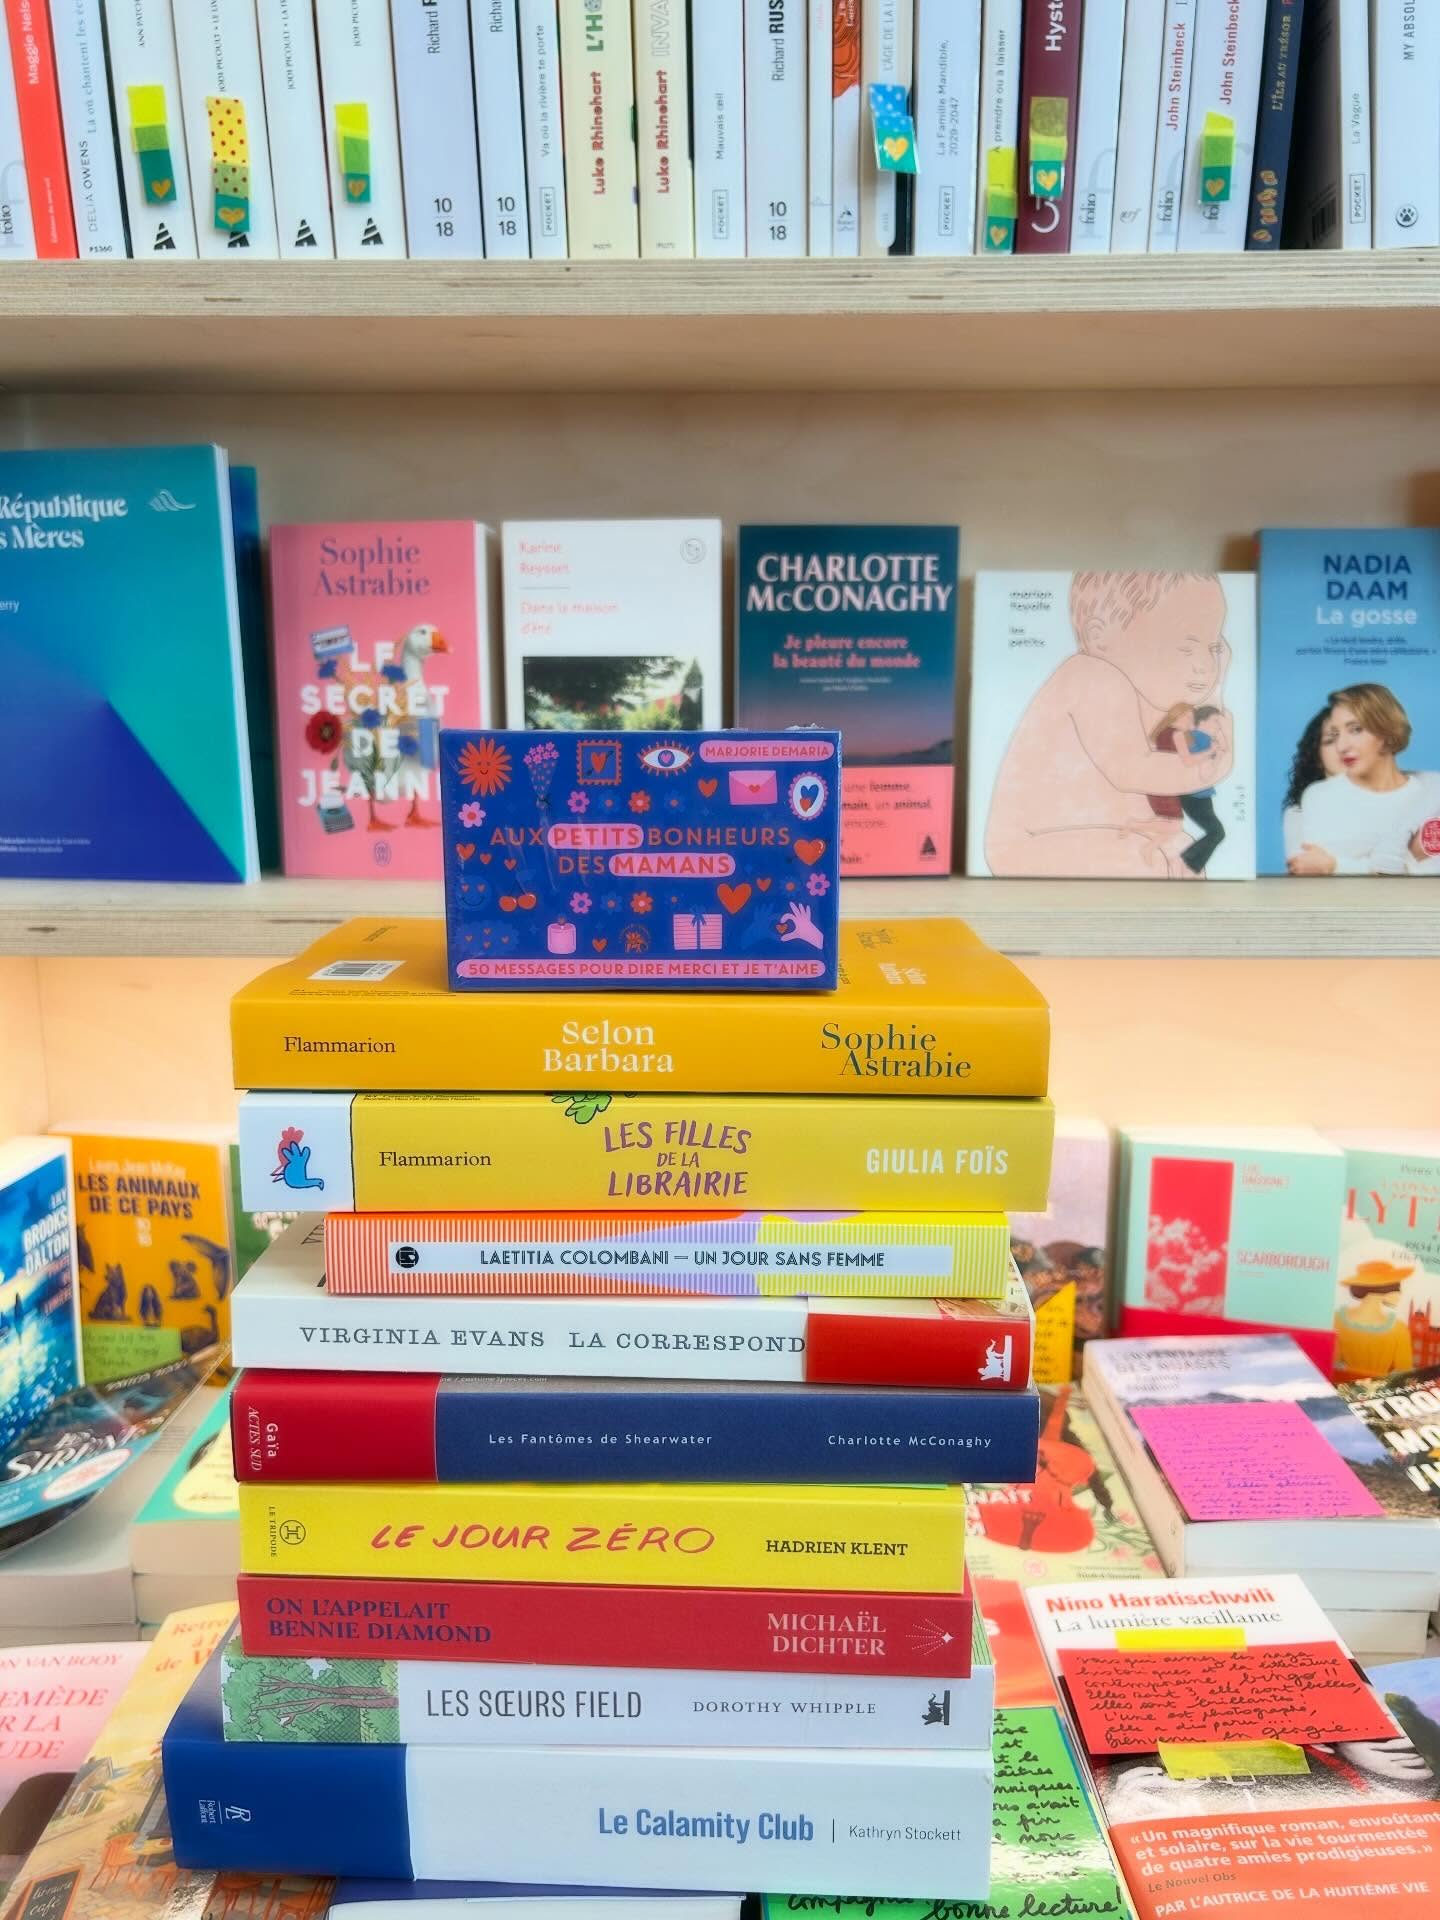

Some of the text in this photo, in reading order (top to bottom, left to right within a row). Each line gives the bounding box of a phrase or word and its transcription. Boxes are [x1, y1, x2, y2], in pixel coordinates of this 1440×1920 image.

[427, 10, 441, 54] Richard
[536, 25, 548, 55] porte
[882, 24, 894, 41] DE
[27, 34, 42, 85] Maggie
[213, 33, 225, 70] PICOULT
[771, 38, 785, 81] Richard
[1403, 43, 1415, 60] MY
[79, 42, 93, 96] chantent
[1166, 22, 1185, 131] John Steinbeck
[1220, 71, 1234, 105] John
[937, 100, 947, 137] Famille
[1351, 92, 1363, 127] Vague
[588, 71, 606, 195] Luke Rhinehart
[655, 69, 670, 193] Luke Rhinehart
[714, 113, 725, 160] Mauvais
[79, 140, 98, 232] DELIA OWENS
[433, 197, 453, 213] 10
[496, 196, 516, 212] 10
[769, 201, 787, 216] 10
[1080, 193, 1096, 224] folio
[1157, 191, 1174, 224] folio
[435, 221, 454, 237] 18
[499, 220, 517, 236] 18
[769, 226, 787, 241] 18
[13, 524, 85, 549] Mères
[319, 536, 421, 574] Sophie
[757, 553, 940, 583] CHARLOTTE
[1323, 555, 1412, 575] NADIA
[313, 568, 431, 597] Astrabie
[1326, 581, 1409, 601] DAAM
[1315, 606, 1419, 630] La gosse
[805, 633, 853, 652] pleure
[792, 653, 921, 669] beauté monde
[300, 684, 450, 716] SECRET
[351, 728, 400, 759] DE
[705, 745, 830, 758] MARJORIE DEMARIA
[490, 827, 792, 846] AUX PETITS BONHEURS
[558, 855, 731, 874] DES MAMANS
[468, 962, 762, 976] 50 MESSAGES POUR DIRE MERCI ET JE
[284, 1019, 937, 1058] Flammarion Selon Sophie
[543, 1047, 972, 1078] Barbara Astrabie
[604, 1119, 752, 1154] LES FILLES
[378, 1150, 492, 1167] Flammarion
[656, 1151, 700, 1168] DE LA
[866, 1145, 1009, 1175] GIULIA FOÏS
[116, 1175, 201, 1200] ANIMAUX
[607, 1170, 749, 1198] LIBRAIRIE
[89, 1194, 193, 1219] DE PAYS
[23, 1203, 68, 1254] BROOKS
[480, 1249, 885, 1267] LAETITIA COLOMBANI UN JOUR SANS FEMME
[299, 1326, 606, 1349] VIRGINIA EVANS LA
[247, 1406, 261, 1447] ACTES
[488, 1431, 993, 1449] Les Fantômes de Shearwater Charlotte McConaghy
[371, 1522, 716, 1554] LE JOUR ZÉRO
[766, 1539, 909, 1557] HADRIEN KLENT
[266, 1598, 451, 1620] ON L'APPELAIT
[1046, 1587, 1277, 1615] Nino Haratischwili
[269, 1619, 492, 1643] BENNIE DIAMOND
[767, 1611, 887, 1634] MICHAËL
[1053, 1607, 1282, 1634] La lumière vacillante
[772, 1636, 886, 1657] DICHTER
[426, 1688, 877, 1719] LES SŒURS FIELD DOROTHY WHIPPLE
[22, 1714, 62, 1733] LA
[1001, 1738, 1023, 1749] et
[1026, 1796, 1080, 1810] avait
[598, 1807, 962, 1845] Le Calamity Club Kathryn Stockett
[1017, 1811, 1061, 1832] fin
[1172, 1819, 1345, 1842] magnifique roman,
[1135, 1827, 1429, 1861] et solaire, sur la vie tourmentée
[1141, 1851, 1293, 1878] de quatre amies
[1212, 1871, 1238, 1883] Obs
[1155, 1881, 1431, 1918] PAR L'AUTRICE DE LA HUITIÈME VIE
